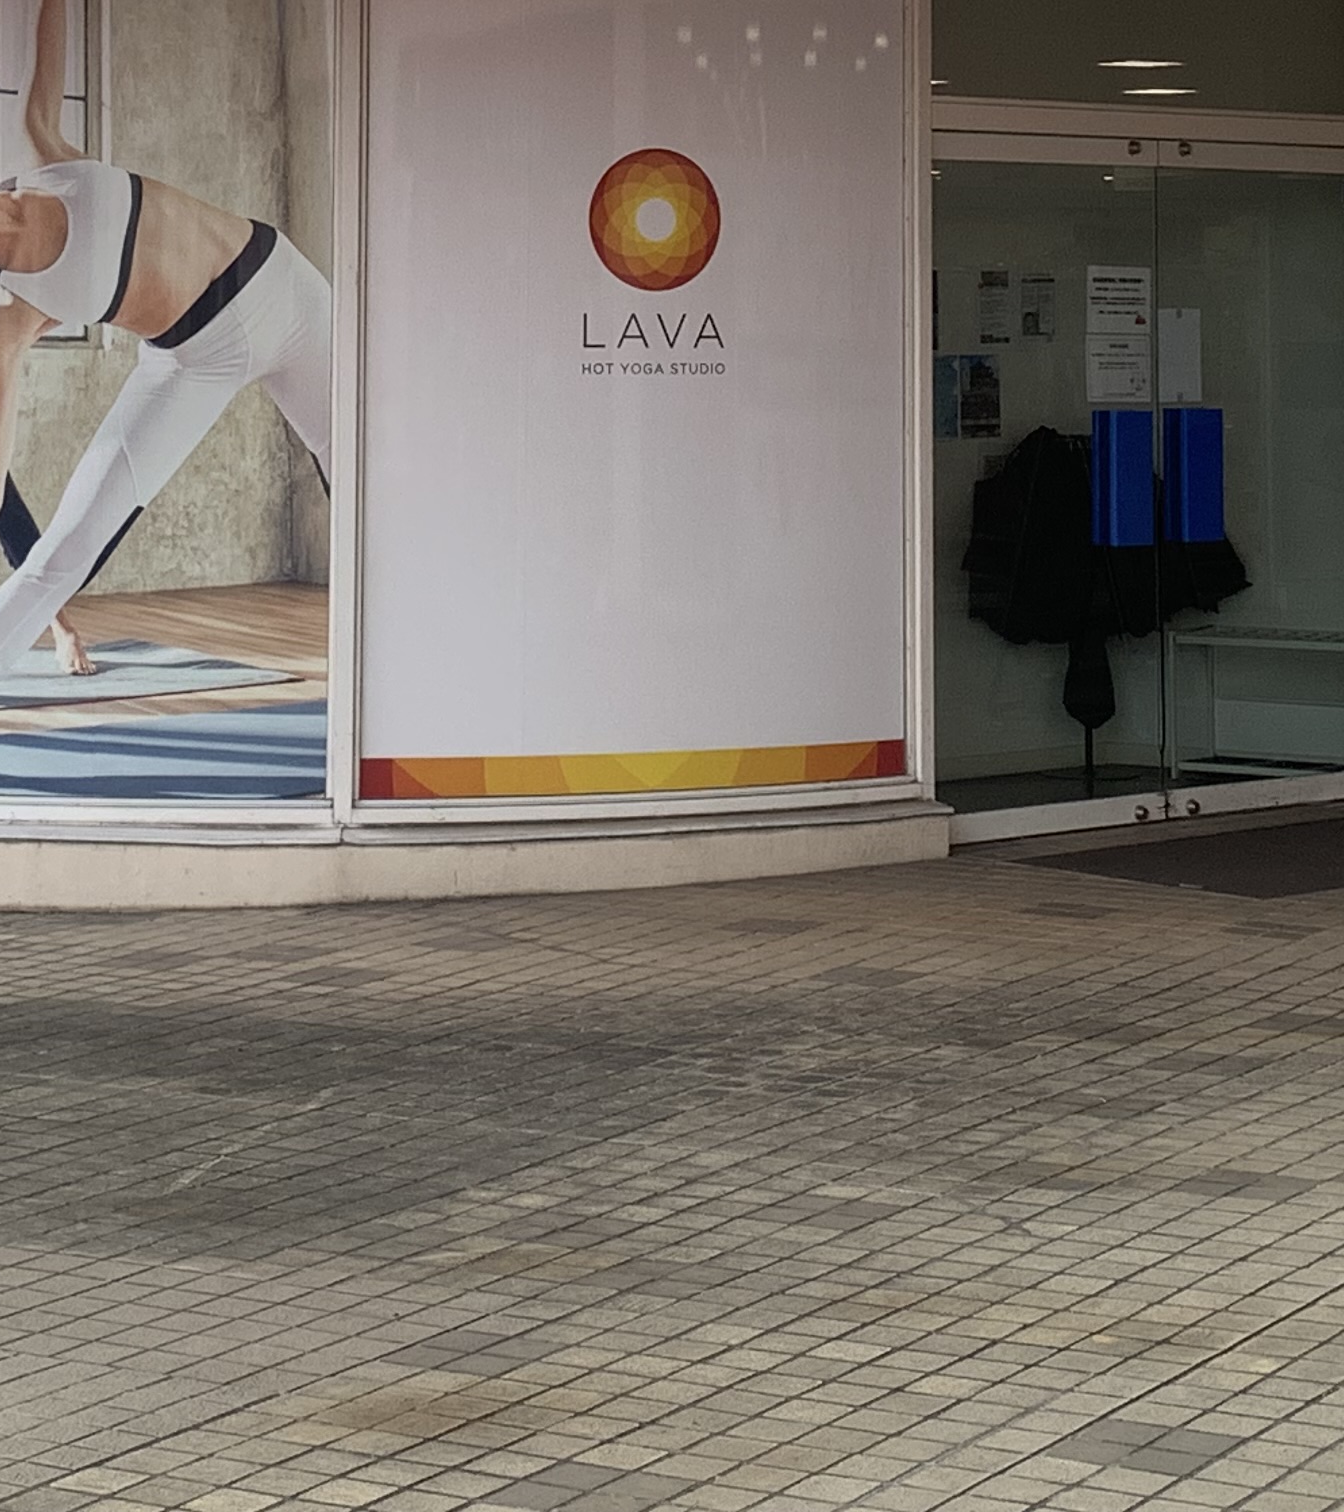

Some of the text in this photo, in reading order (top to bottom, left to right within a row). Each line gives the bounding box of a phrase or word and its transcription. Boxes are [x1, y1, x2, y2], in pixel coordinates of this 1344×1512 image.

[582, 312, 725, 350] LAVA
[581, 362, 726, 376] HOT YOGA STUDIO
